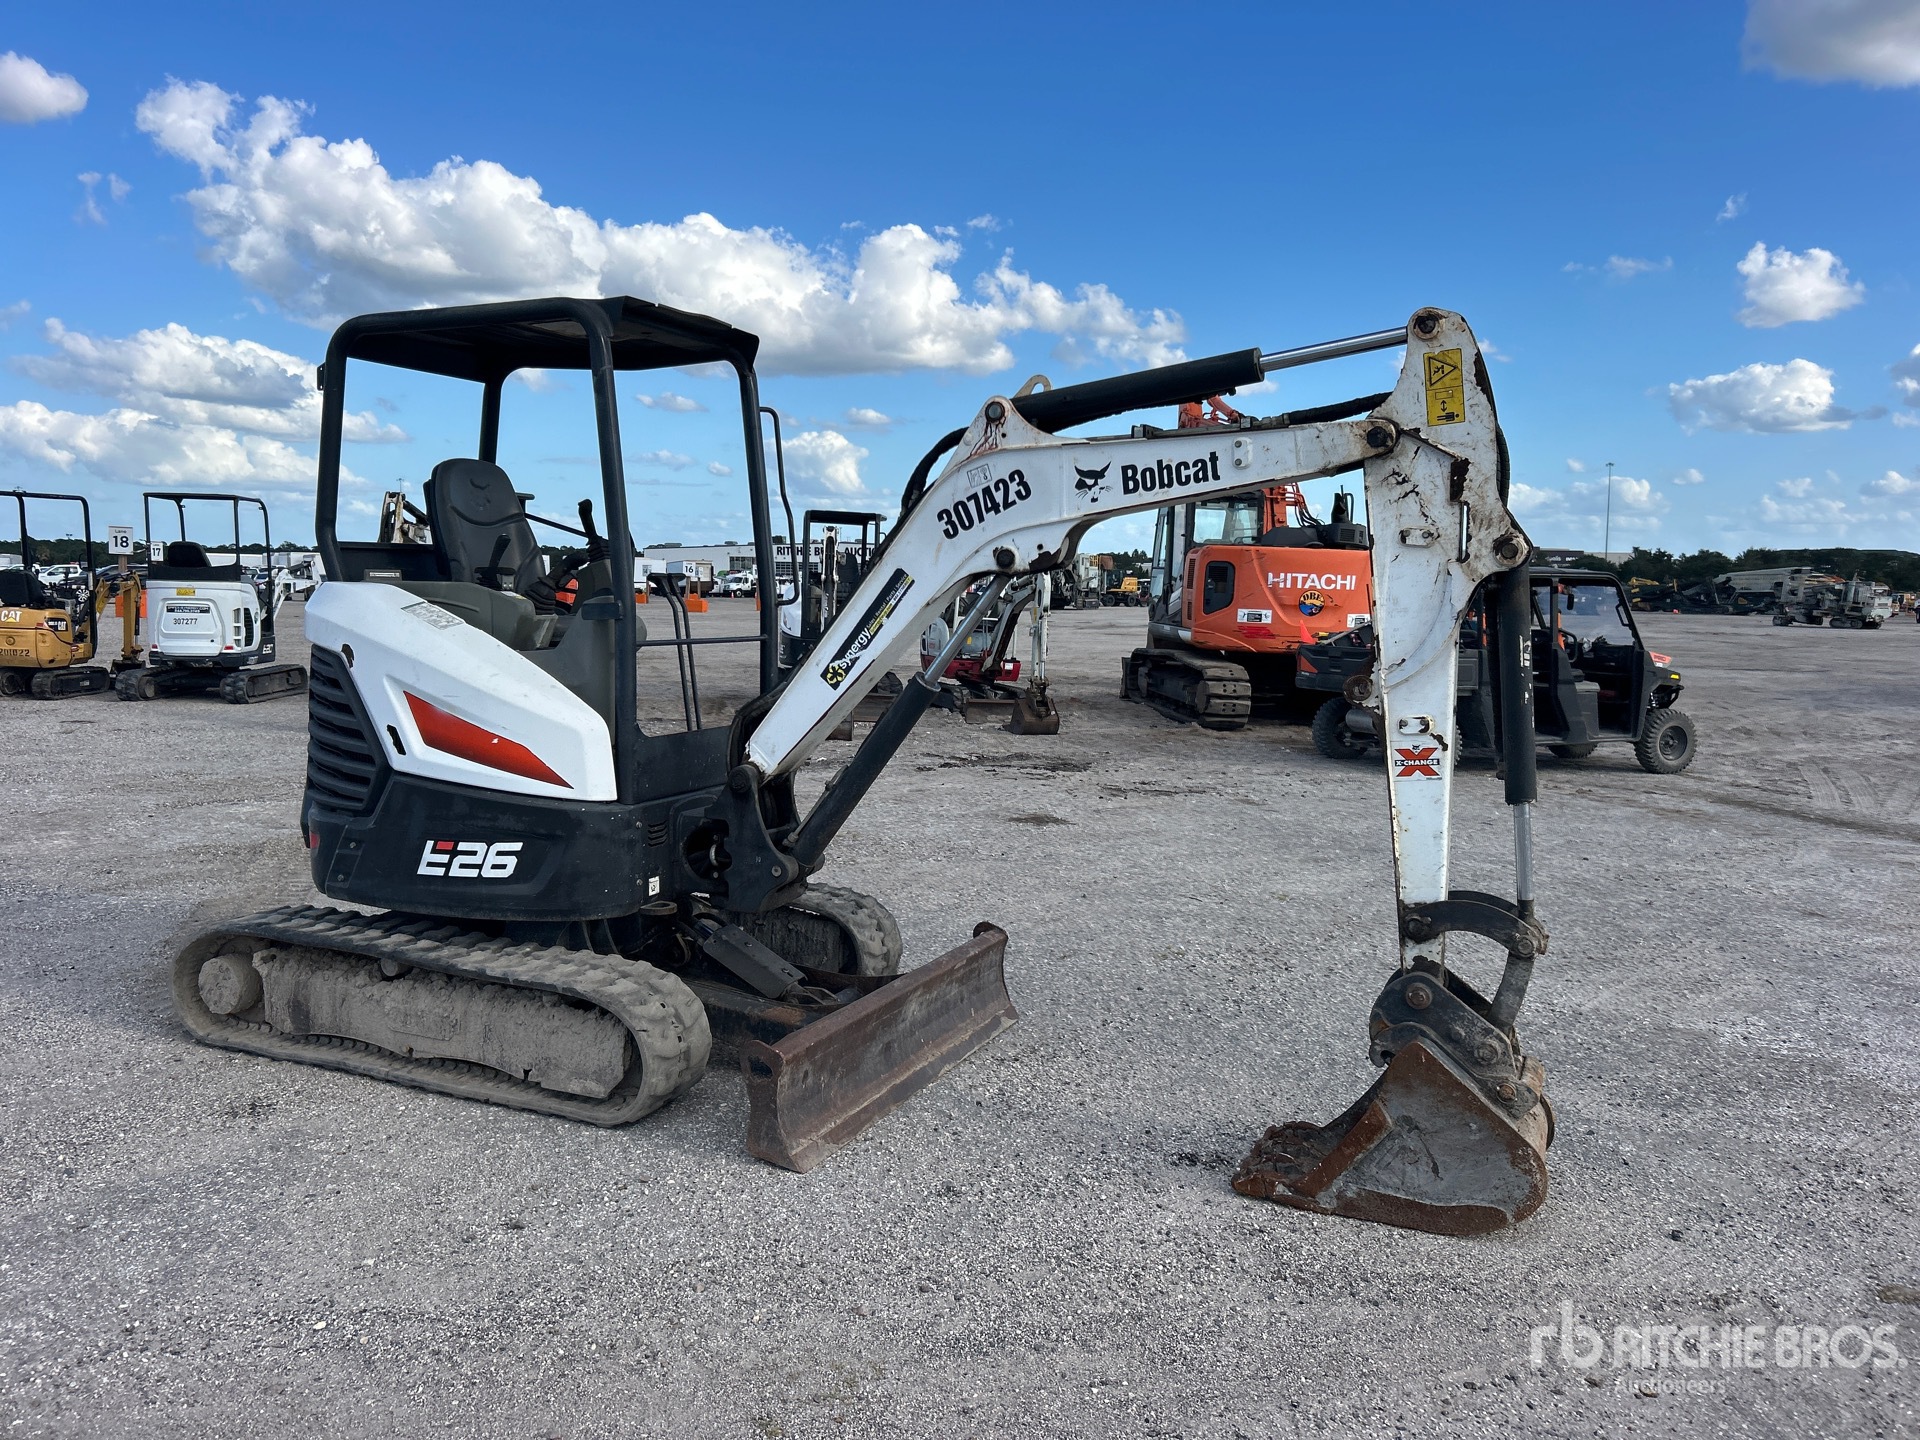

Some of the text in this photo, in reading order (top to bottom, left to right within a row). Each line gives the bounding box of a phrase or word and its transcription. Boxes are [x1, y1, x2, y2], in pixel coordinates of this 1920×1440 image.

[1121, 451, 1221, 495] Bobcat
[936, 468, 1032, 540] 307423
[113, 535, 129, 548] 18
[152, 547, 161, 556] 17
[1267, 572, 1356, 590] HITACHI
[1, 610, 22, 622] CAT
[839, 627, 871, 669] synergy
[416, 839, 523, 878] E26
